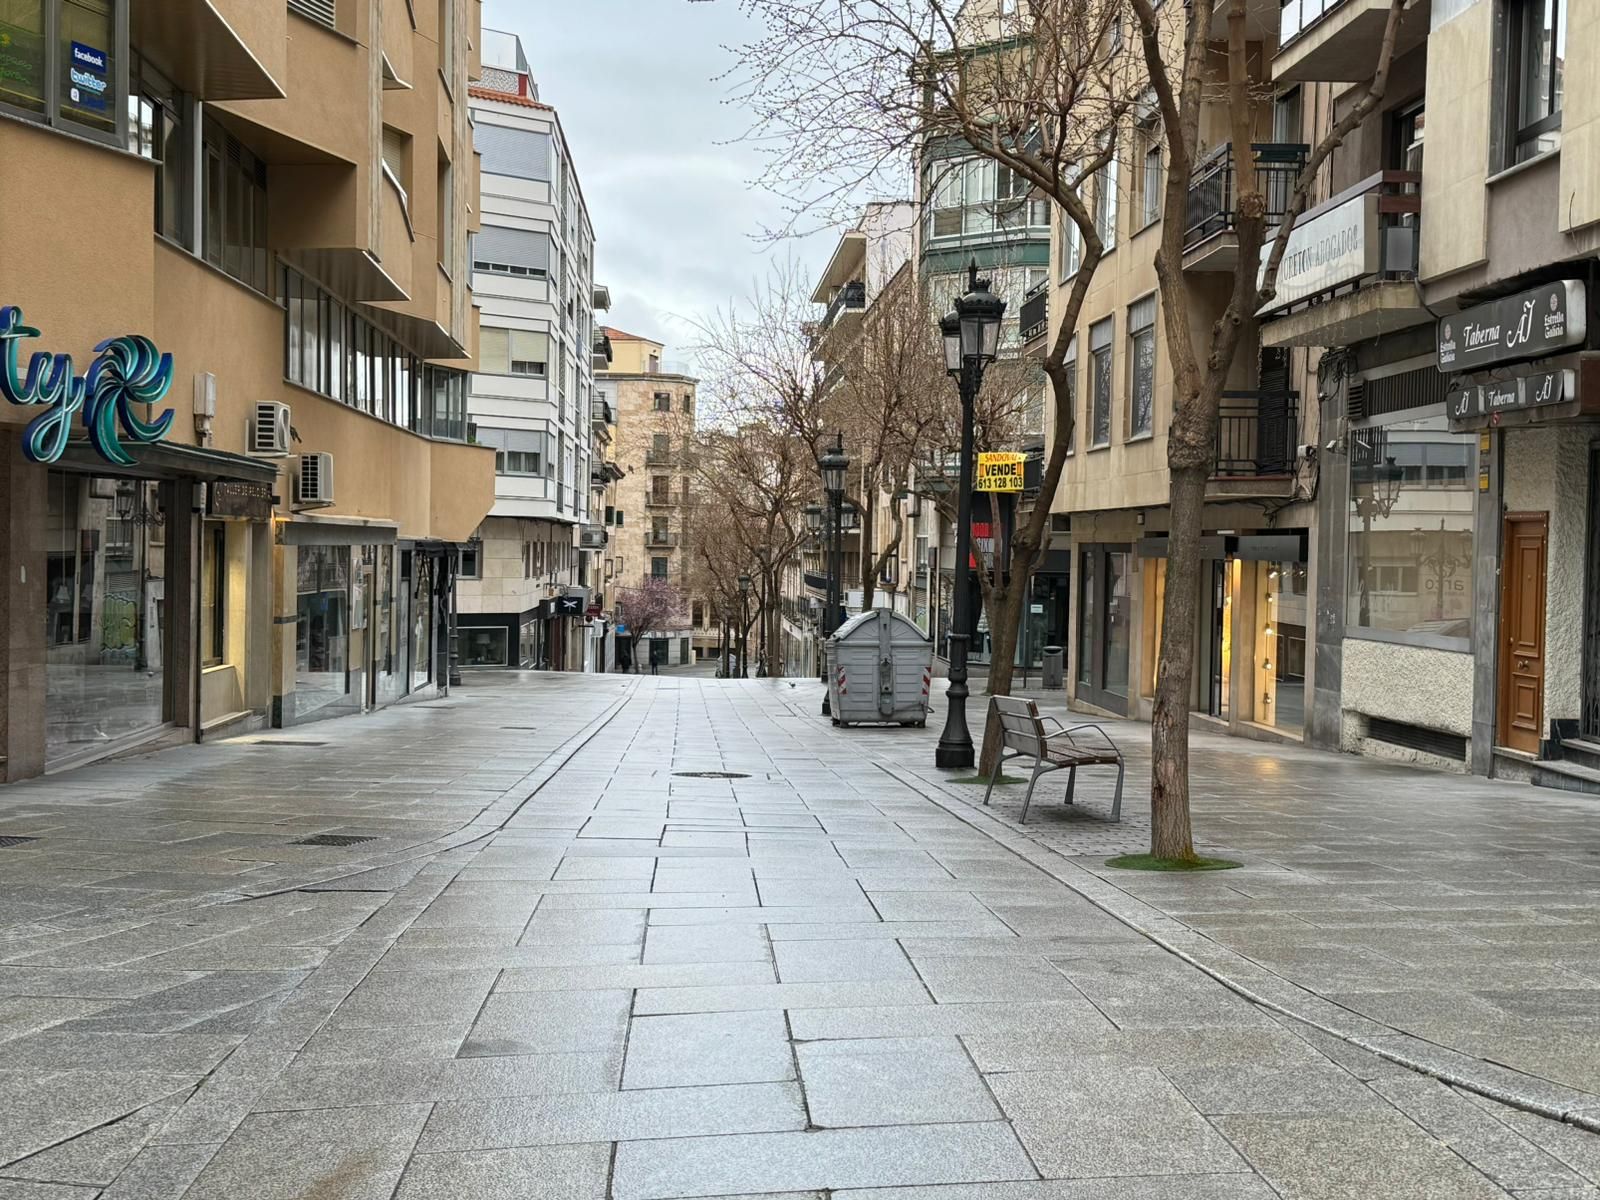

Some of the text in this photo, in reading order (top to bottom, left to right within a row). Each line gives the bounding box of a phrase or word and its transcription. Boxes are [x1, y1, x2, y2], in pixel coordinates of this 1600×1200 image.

[74, 47, 103, 66] facebook
[71, 67, 107, 92] twitter
[1544, 311, 1564, 326] Estrella
[1463, 322, 1500, 347] Taberna
[1545, 326, 1564, 339] Galicia
[1488, 389, 1515, 407] Taberna
[978, 476, 1023, 489] 613 128 103
